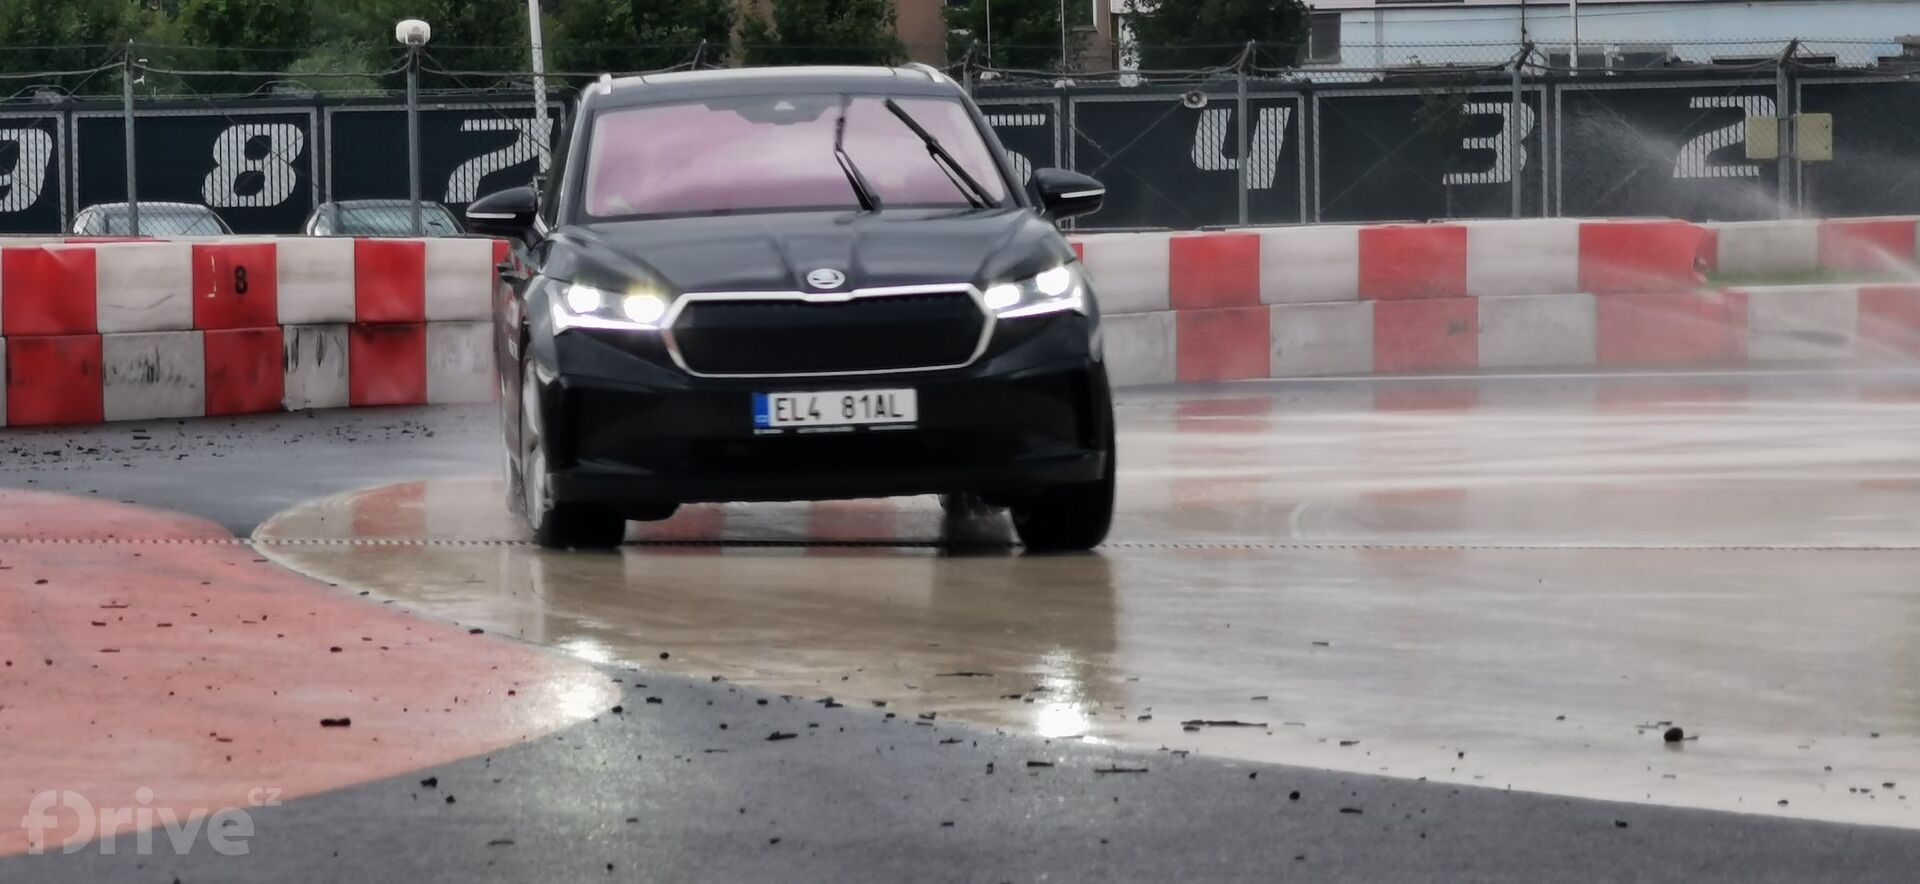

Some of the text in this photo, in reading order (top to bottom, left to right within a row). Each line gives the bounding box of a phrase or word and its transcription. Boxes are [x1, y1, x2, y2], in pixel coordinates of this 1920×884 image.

[201, 123, 304, 208] 8
[1191, 107, 1291, 190] 4
[1442, 102, 1535, 185] 3
[1673, 95, 1776, 178] 2
[235, 265, 249, 295] 8
[774, 394, 904, 422] EL4 81AL
